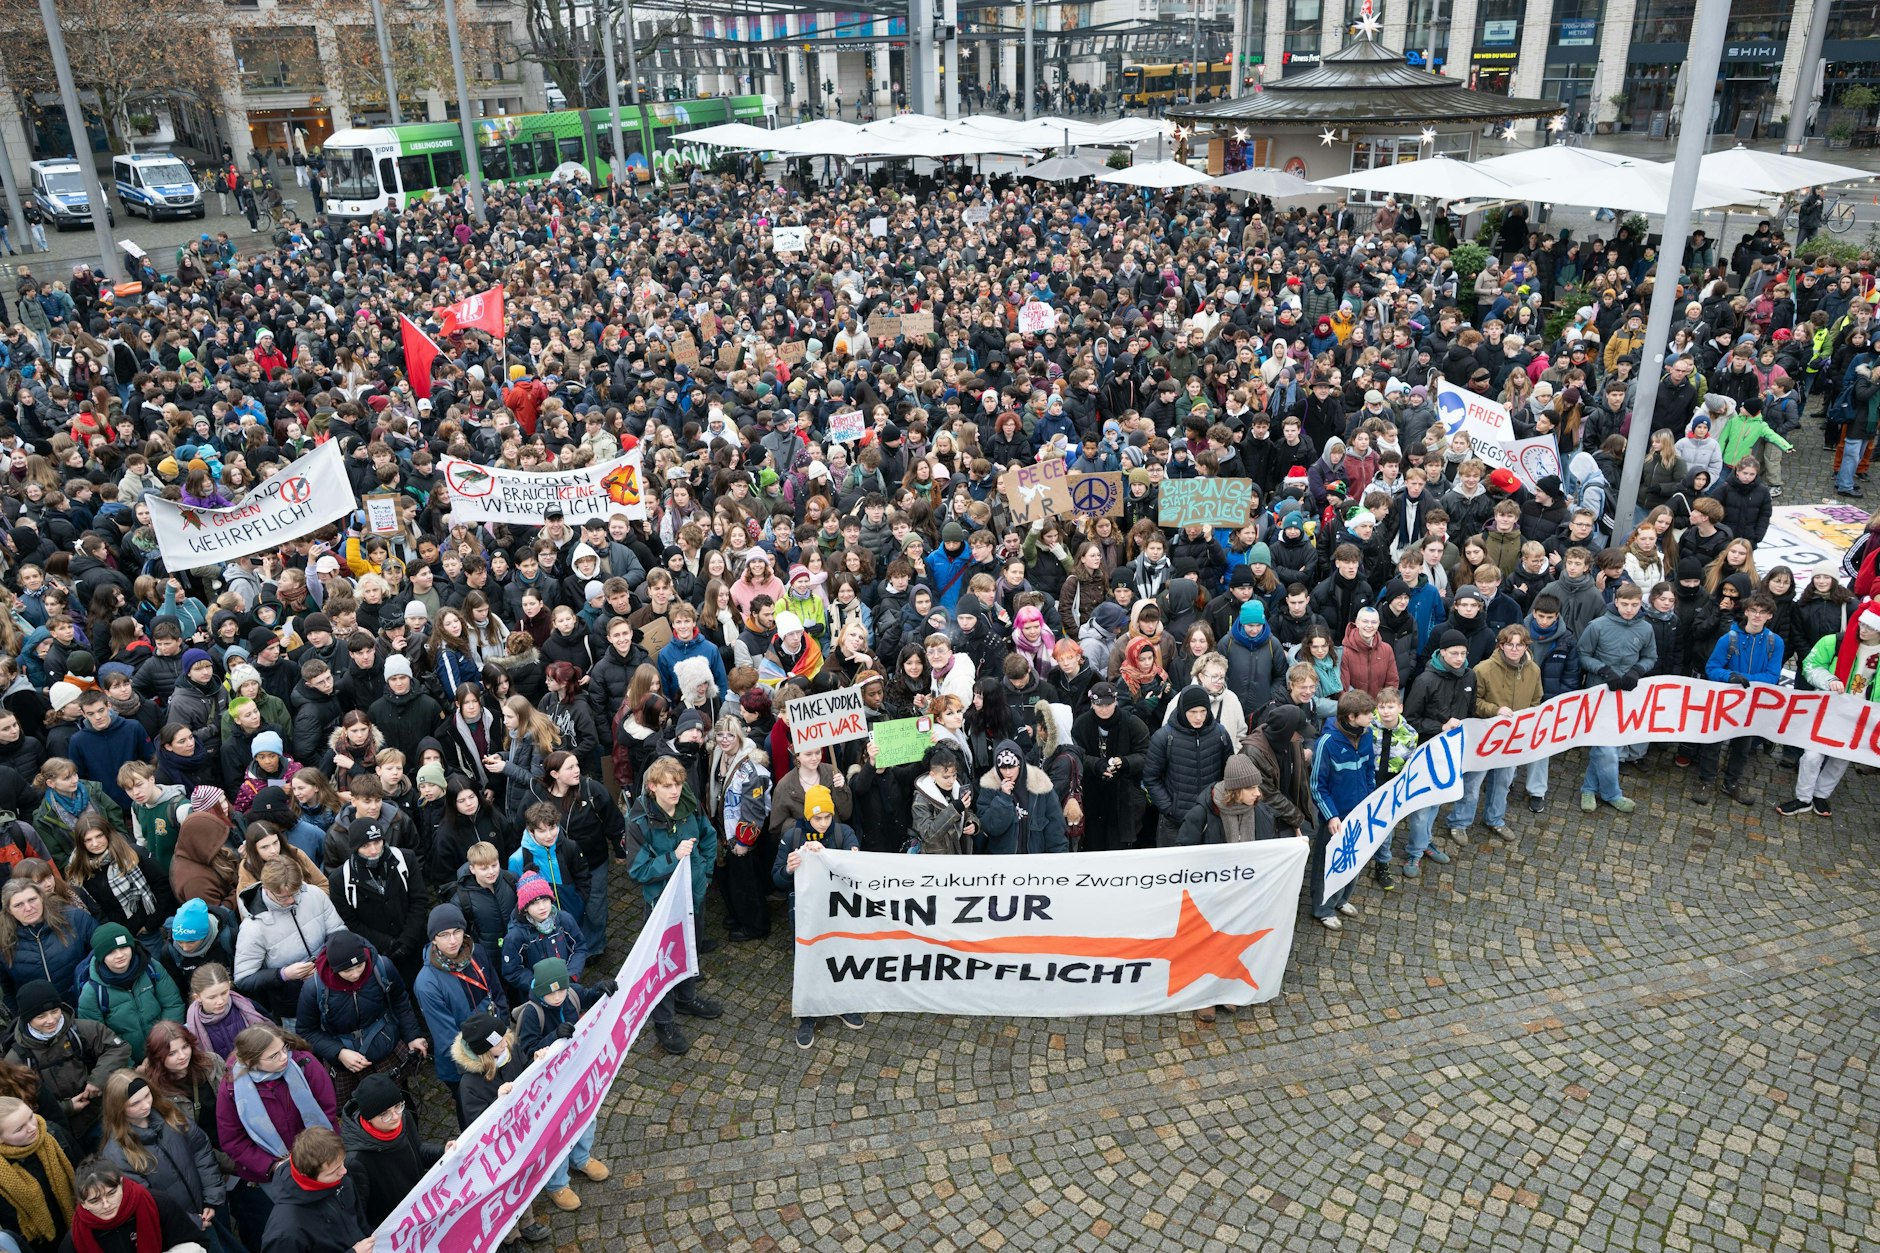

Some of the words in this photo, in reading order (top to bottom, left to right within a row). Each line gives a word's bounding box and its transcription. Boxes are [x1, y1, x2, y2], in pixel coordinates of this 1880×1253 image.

[1728, 47, 1777, 57] SHIKI
[410, 139, 454, 150] LIEBLINGSORTE
[503, 485, 559, 502] BRAUCHT
[558, 484, 598, 500] KEINE
[1160, 495, 1190, 509] STATT
[212, 503, 261, 527] GEGEN
[1187, 500, 1247, 524] KRIEG
[188, 500, 315, 554] WEHRPFLICHT
[790, 698, 827, 723] MAKE
[825, 692, 862, 713] VODKA
[797, 722, 827, 744] NOT
[829, 713, 866, 737] WAR.
[1476, 689, 1605, 758] GEGEN
[868, 876, 916, 891] eine
[920, 873, 1007, 888] Zukunft
[1012, 874, 1070, 887] ohne
[1075, 865, 1256, 889] Zwangsdienste
[829, 891, 937, 926] NEIN
[952, 894, 1054, 924] ZUR
[825, 953, 1152, 984] WEHRPFLICHT
[390, 1174, 452, 1252] OUR
